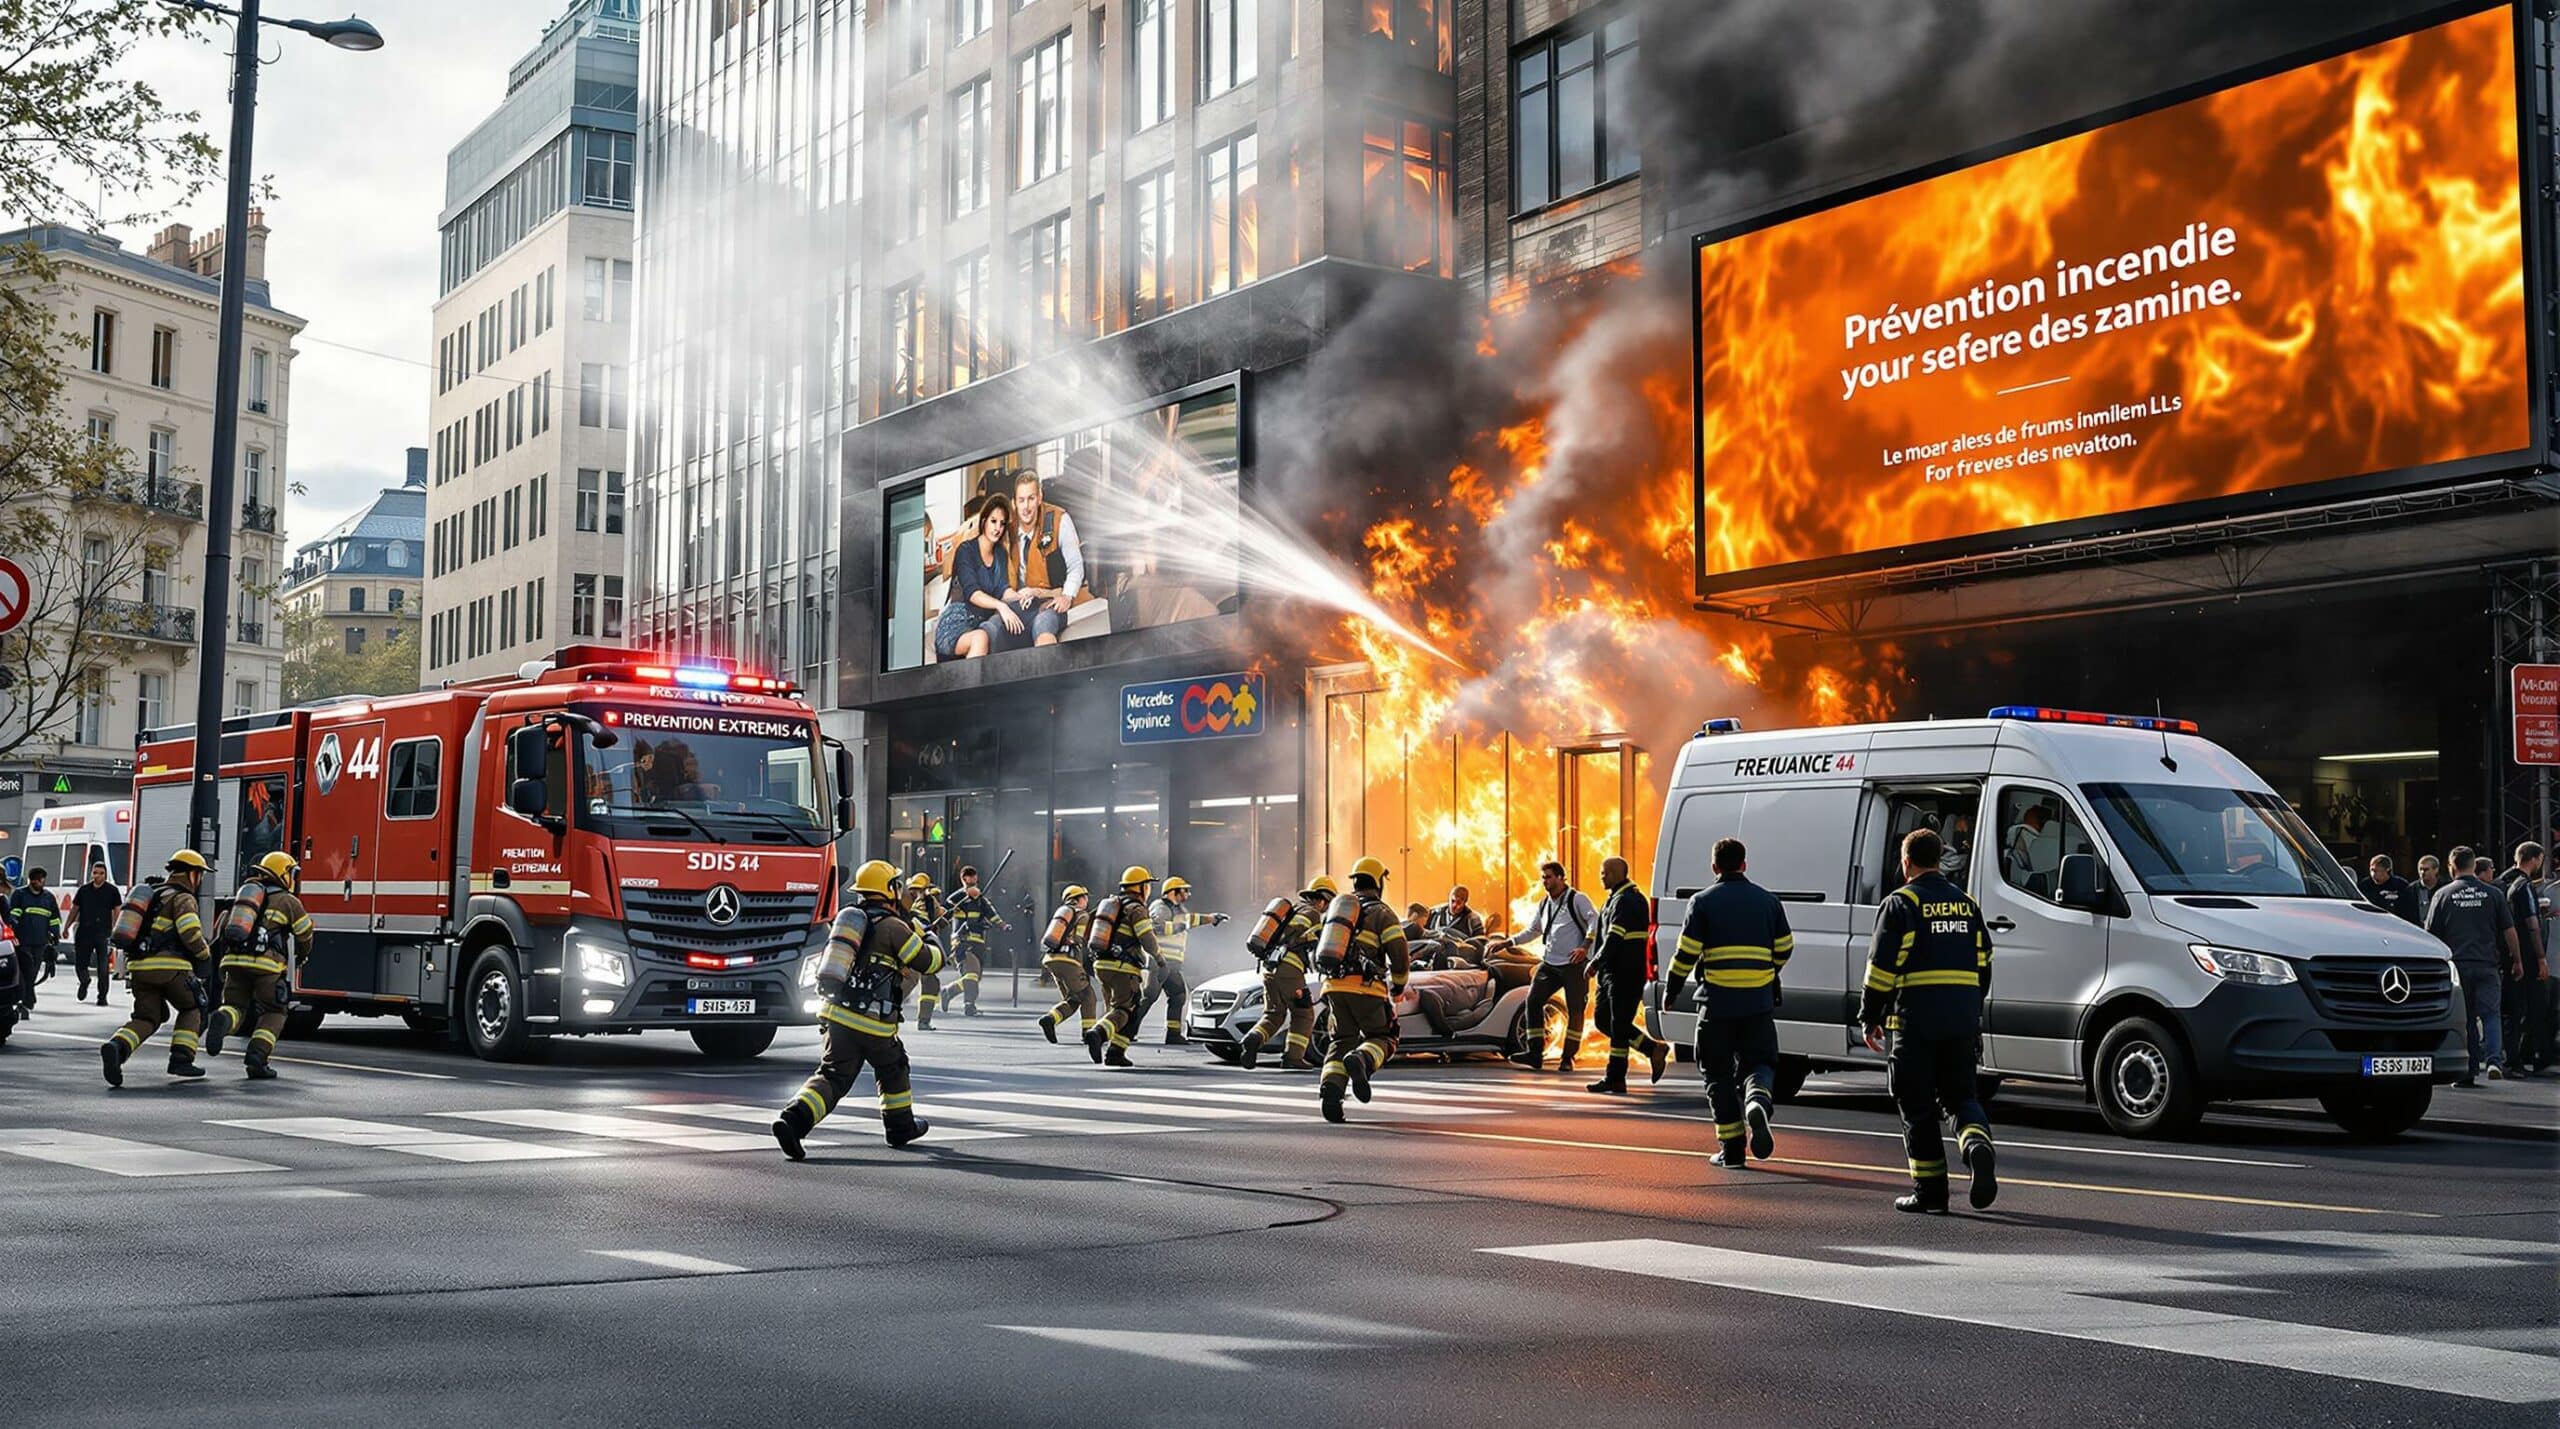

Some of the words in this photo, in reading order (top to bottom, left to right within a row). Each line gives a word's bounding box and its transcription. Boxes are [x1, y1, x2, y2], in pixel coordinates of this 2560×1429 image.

[1845, 277, 2046, 349] Prévention
[2057, 222, 2236, 297] incendie
[1841, 354, 1915, 401] your
[1922, 332, 2022, 374] sefere
[2029, 313, 2088, 348] des
[2094, 278, 2242, 334] zamine.
[1883, 449, 1903, 466] Le
[1995, 425, 2017, 444] de
[1925, 465, 1954, 483] For
[1957, 455, 2013, 477] freves
[2017, 447, 2048, 466] des
[624, 712, 714, 731] PREVENTION
[718, 720, 790, 738] EXTREMIS
[347, 736, 380, 780] 44
[1836, 754, 1855, 771] 44
[687, 852, 736, 871] SDIS
[739, 855, 760, 871] 44
